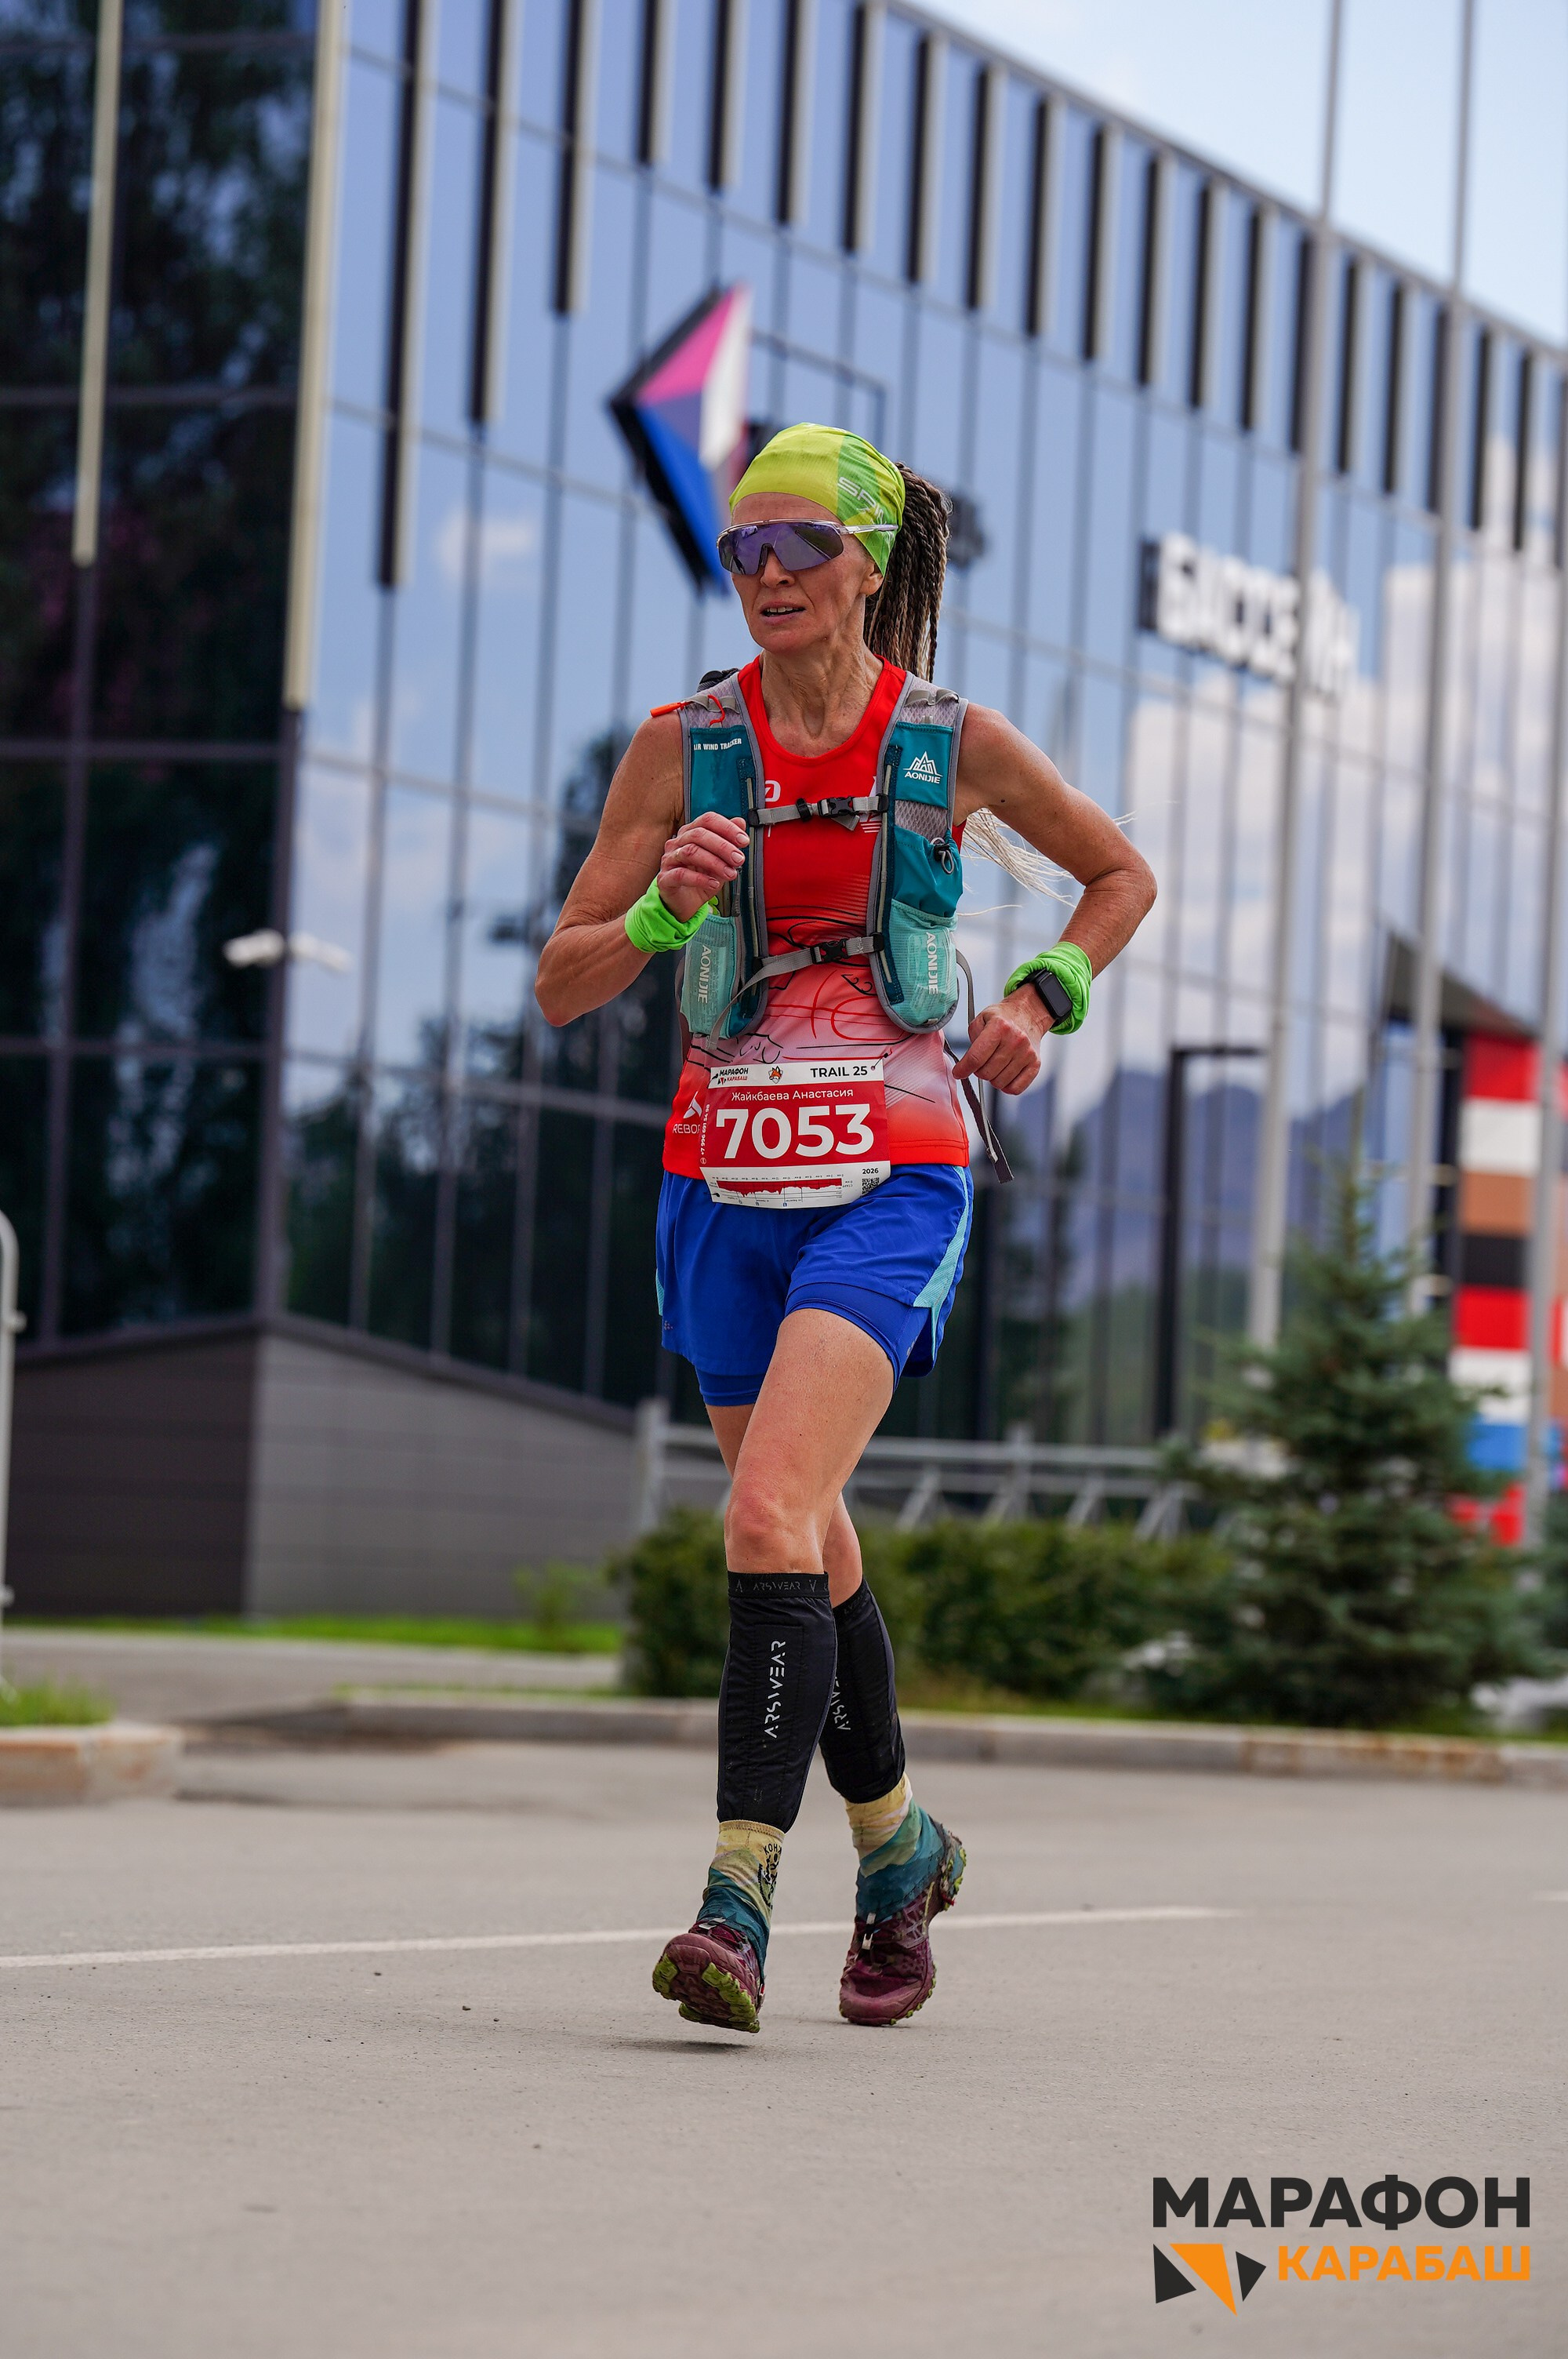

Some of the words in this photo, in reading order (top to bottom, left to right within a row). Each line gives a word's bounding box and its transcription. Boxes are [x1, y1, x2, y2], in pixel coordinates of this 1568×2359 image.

[720, 738, 742, 750] TRACKER
[904, 771, 941, 784] AONIJIE
[926, 932, 938, 994] AONIJIE
[698, 944, 712, 1004] AONIJIE
[719, 1067, 749, 1077] МАРАФОН
[810, 1067, 849, 1078] TRAIL
[853, 1066, 868, 1076] 25
[731, 1091, 789, 1101] Жайкбаева
[793, 1089, 854, 1100] Анастасия
[716, 1103, 874, 1159] 7053
[764, 1641, 786, 1738] ARSWEAR
